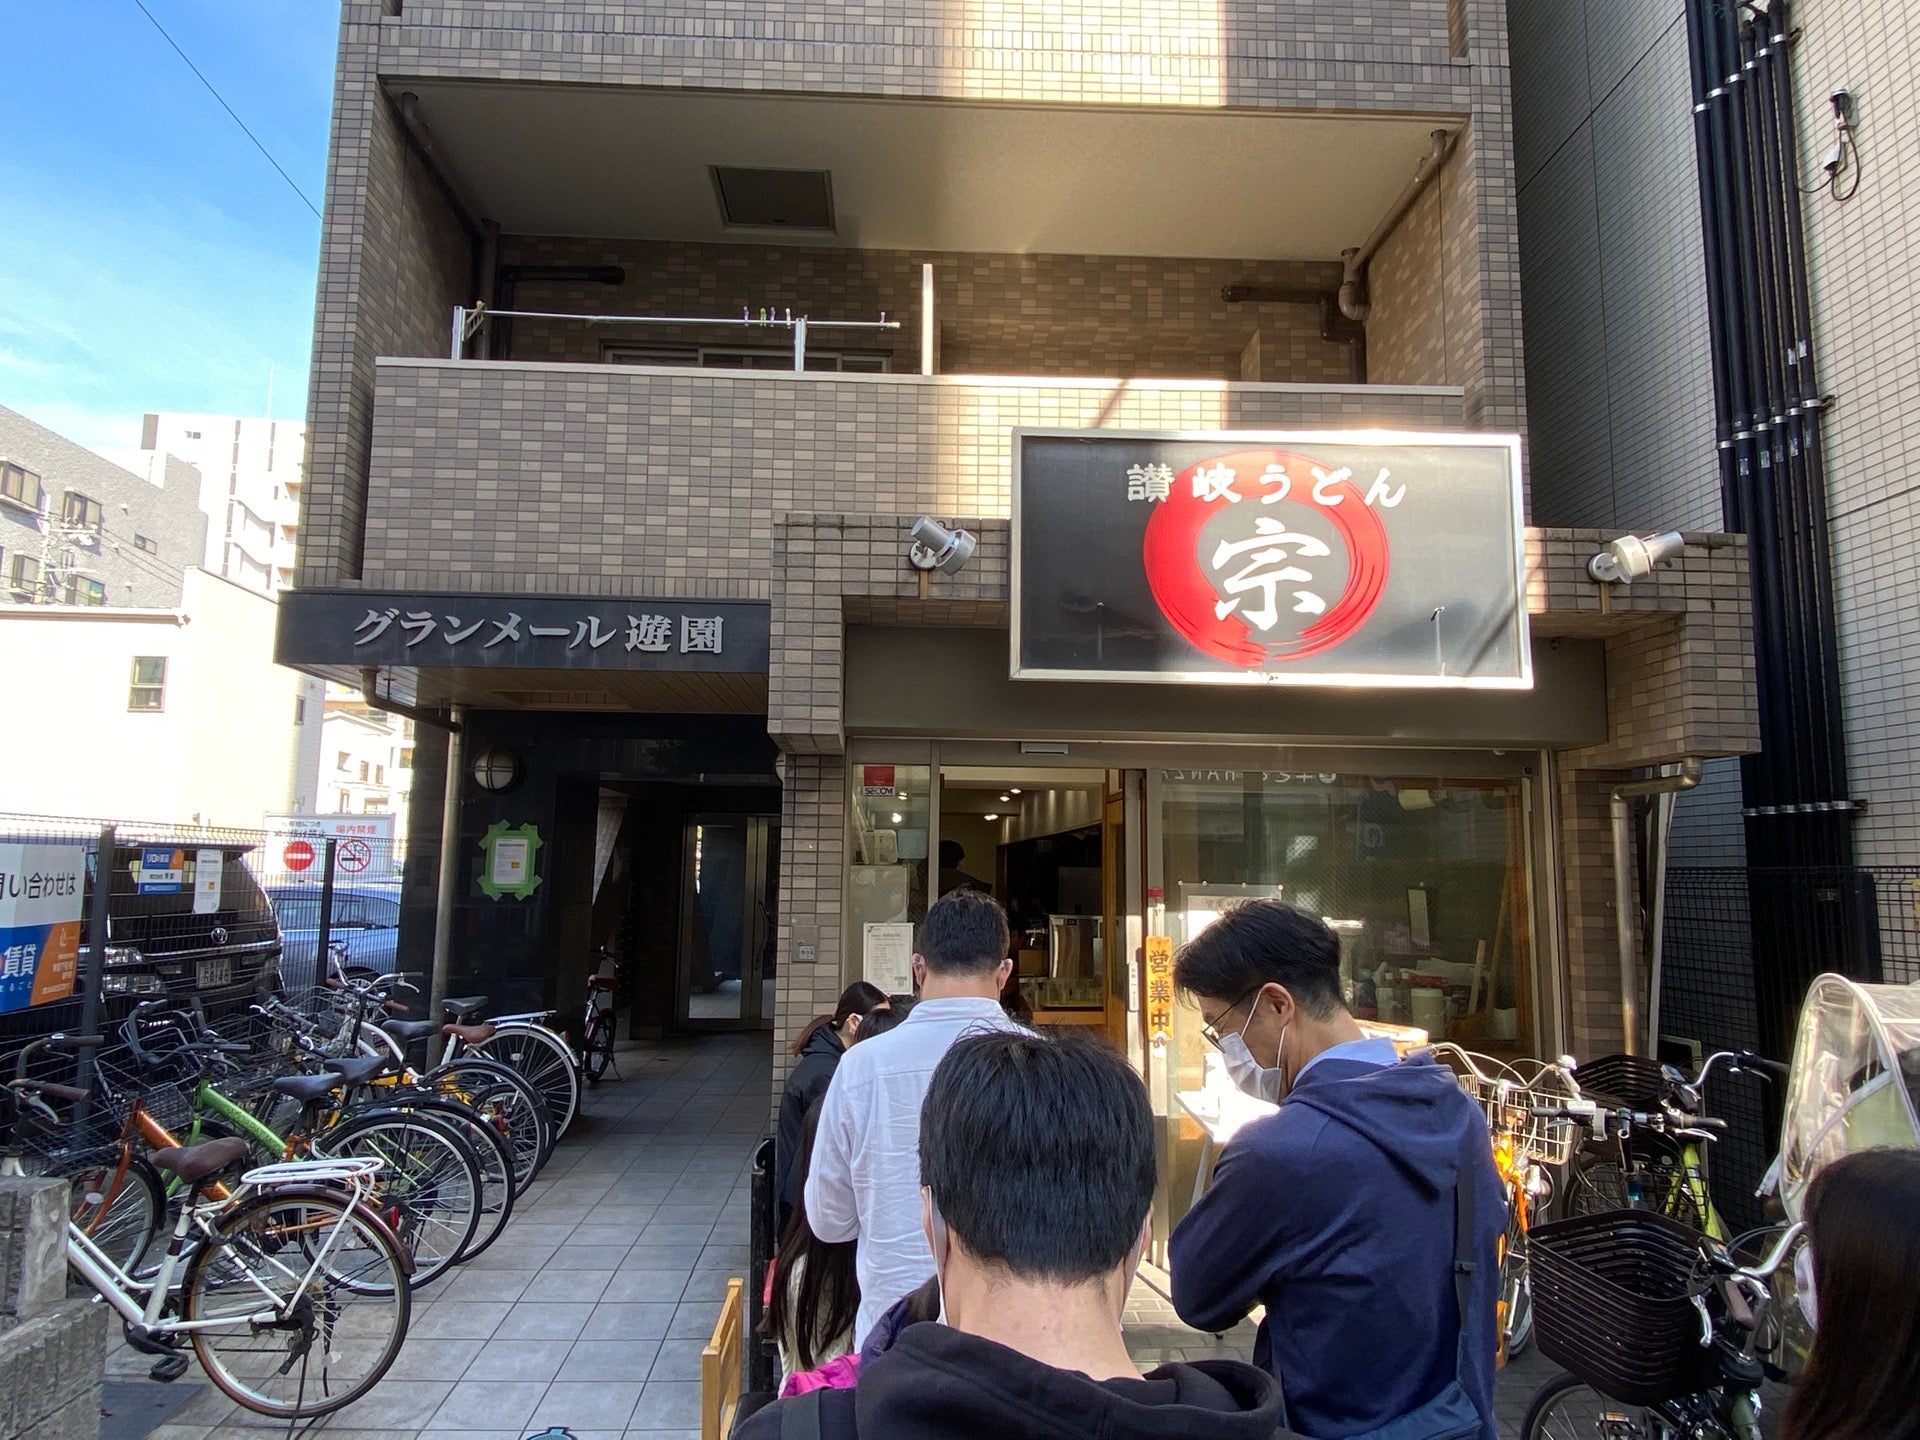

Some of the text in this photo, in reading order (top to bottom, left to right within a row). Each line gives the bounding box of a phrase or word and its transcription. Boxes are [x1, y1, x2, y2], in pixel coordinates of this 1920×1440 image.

[1126, 463, 1407, 508] 讃岐うどん
[1211, 516, 1331, 631] 宗
[354, 607, 724, 655] グランメール遊園
[864, 787, 894, 796] SECOM
[1149, 949, 1171, 1032] 営業中
